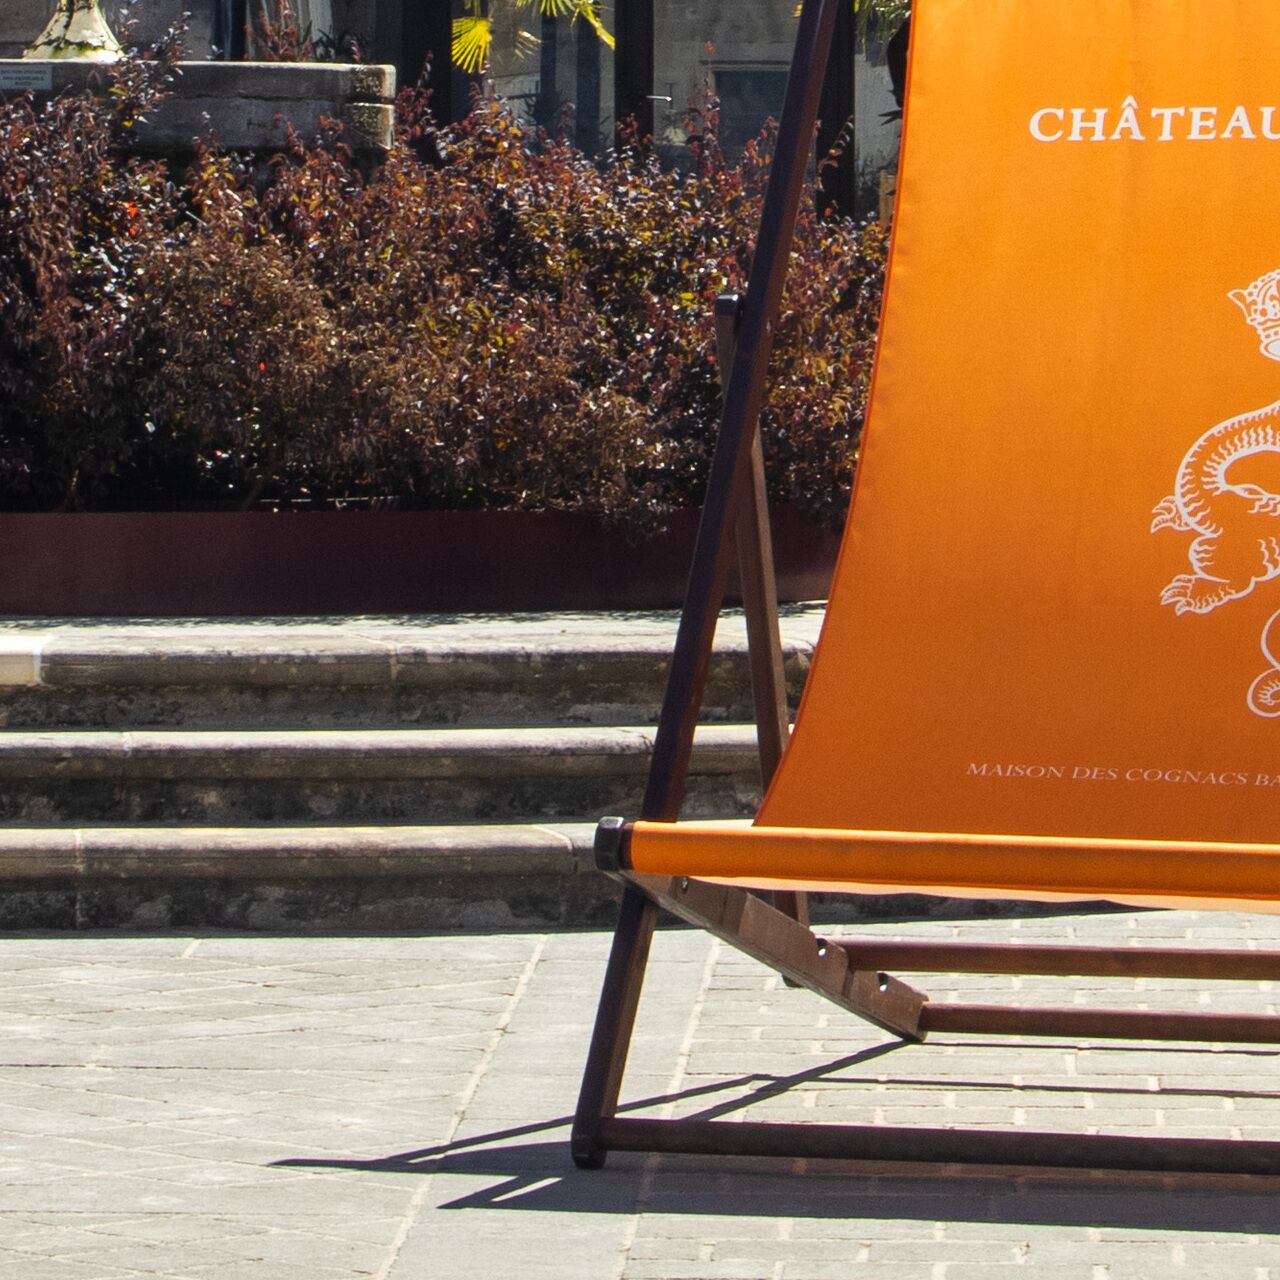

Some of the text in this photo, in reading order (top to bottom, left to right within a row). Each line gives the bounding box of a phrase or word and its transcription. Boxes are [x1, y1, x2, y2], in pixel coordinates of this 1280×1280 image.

[966, 762, 1064, 779] MAISON
[1072, 766, 1119, 781] DES
[1125, 768, 1249, 786] COGNACS
